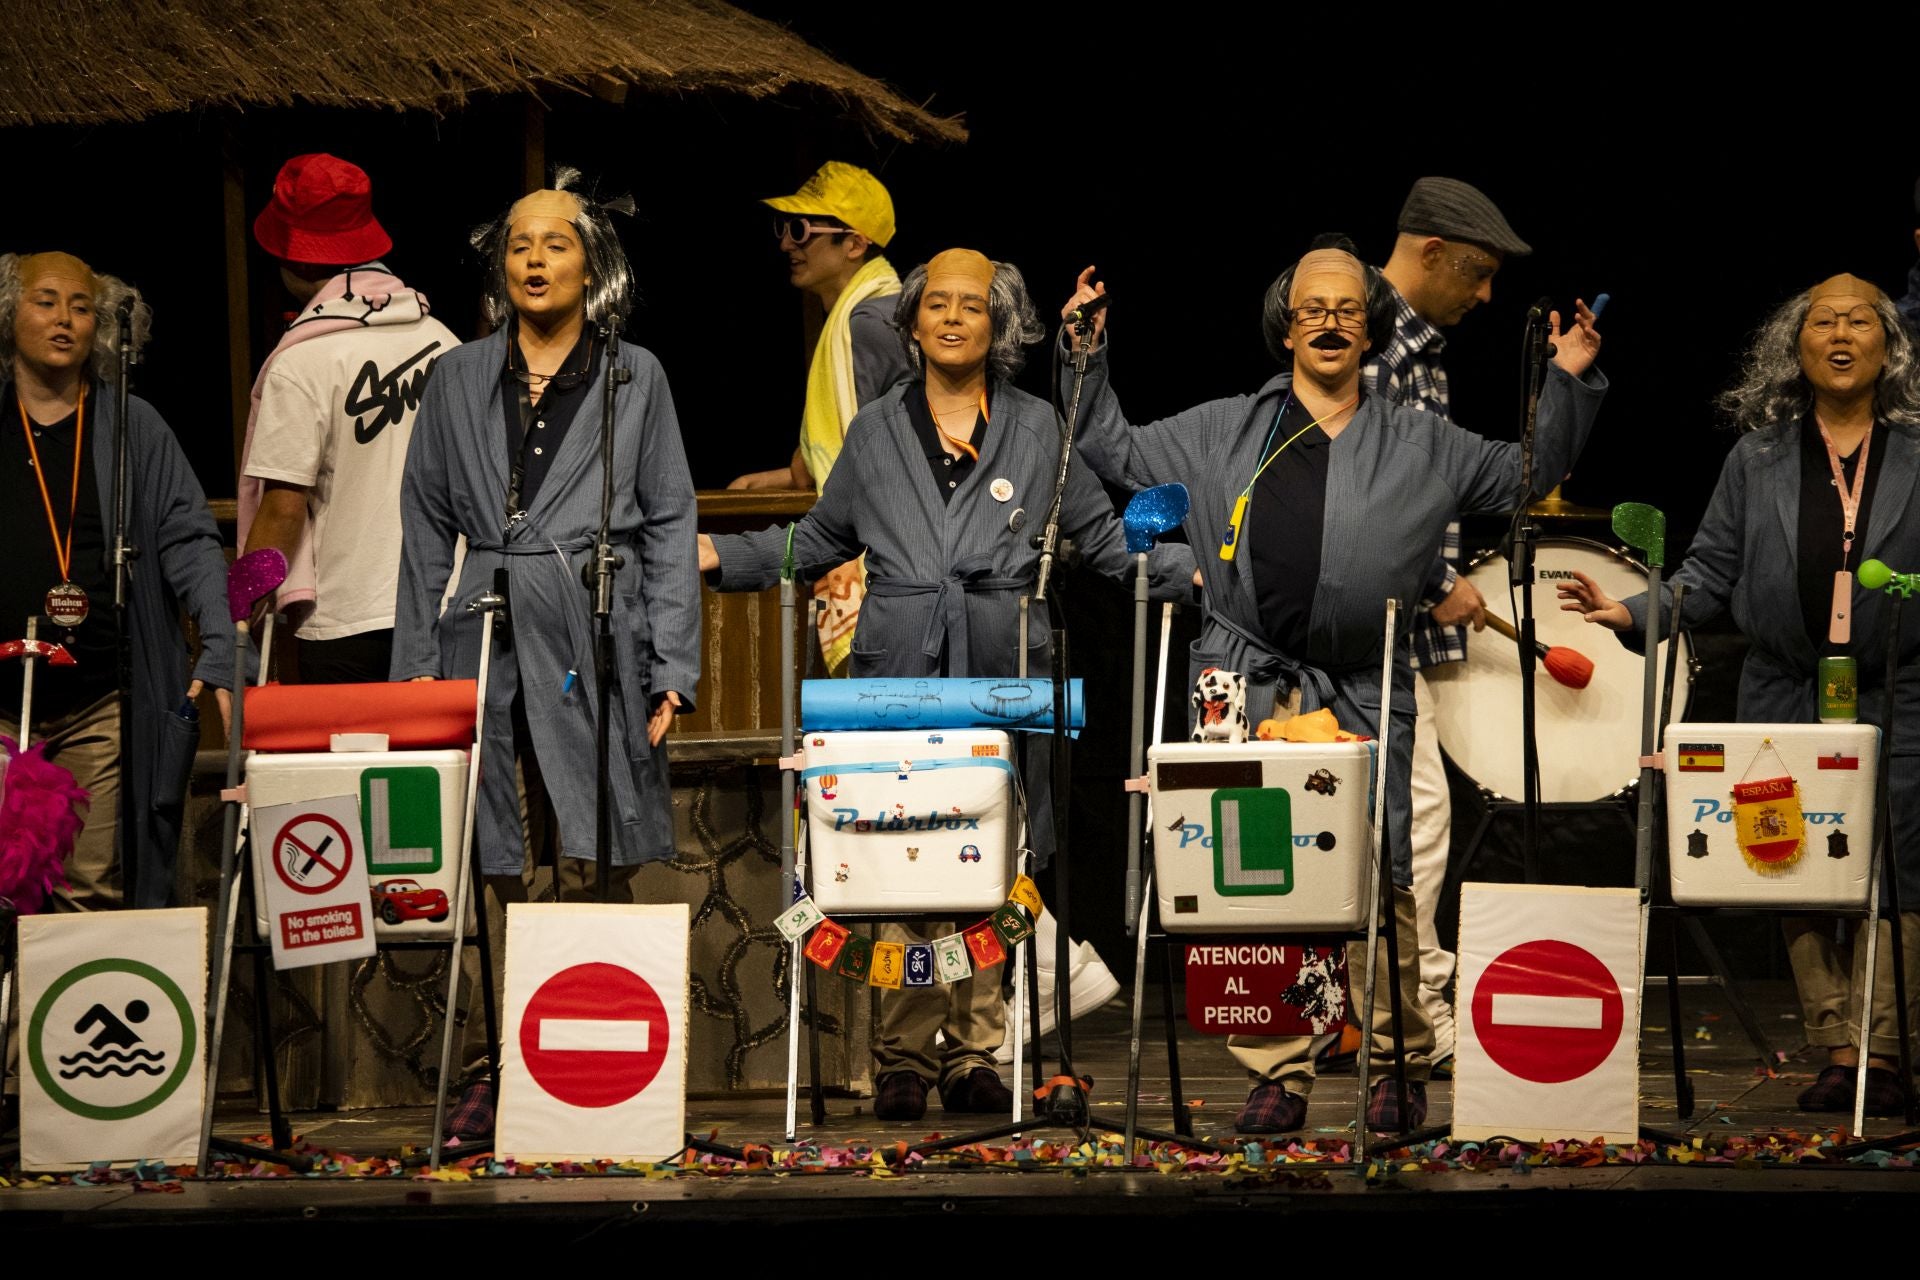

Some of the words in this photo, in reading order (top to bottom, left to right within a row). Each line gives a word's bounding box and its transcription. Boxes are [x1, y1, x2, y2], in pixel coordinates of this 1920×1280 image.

[1540, 570, 1575, 579] EVAN
[1742, 782, 1787, 797] ESPAÑA
[370, 778, 433, 864] L
[832, 808, 980, 831] Plarbox
[1220, 800, 1285, 886] L
[287, 916, 305, 930] No
[306, 910, 352, 925] smoking
[289, 931, 301, 944] in
[302, 929, 320, 943] the
[322, 924, 356, 939] toilets
[1187, 943, 1285, 966] ATENCIÓN
[1224, 976, 1251, 995] AL
[1204, 1005, 1272, 1025] PERRO
